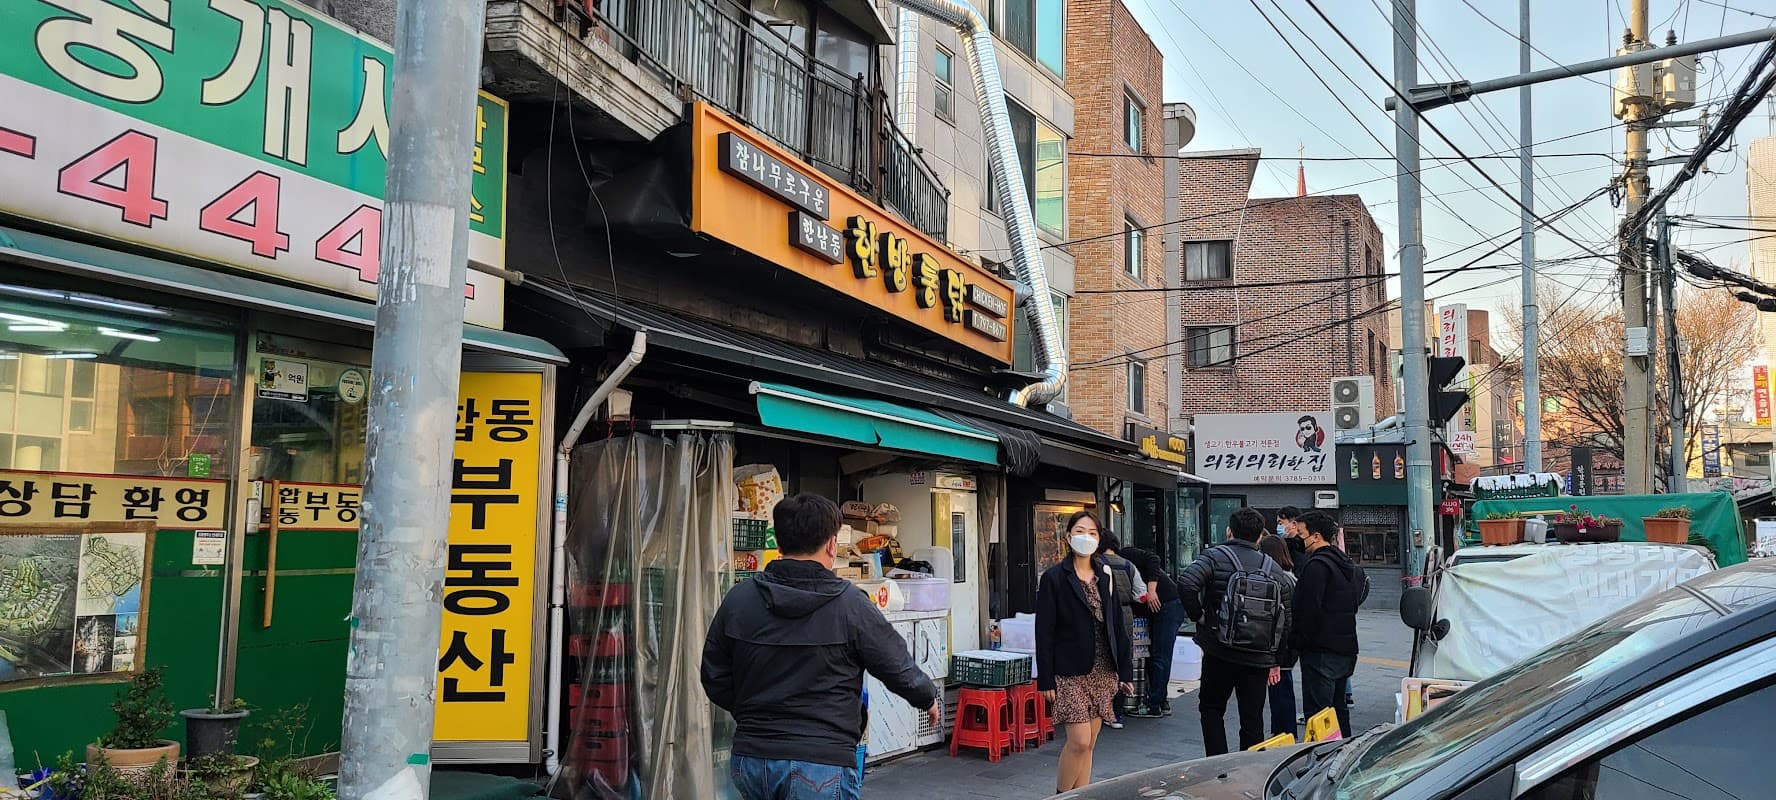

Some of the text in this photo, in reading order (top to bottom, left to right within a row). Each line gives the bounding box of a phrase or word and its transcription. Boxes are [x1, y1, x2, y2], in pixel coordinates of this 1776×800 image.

[735, 142, 825, 213] 참나무로구운
[802, 217, 841, 258] 한남동
[850, 214, 968, 323] 한방통닭
[0, 480, 211, 522] 상담 환영
[438, 458, 520, 703] 부동산
